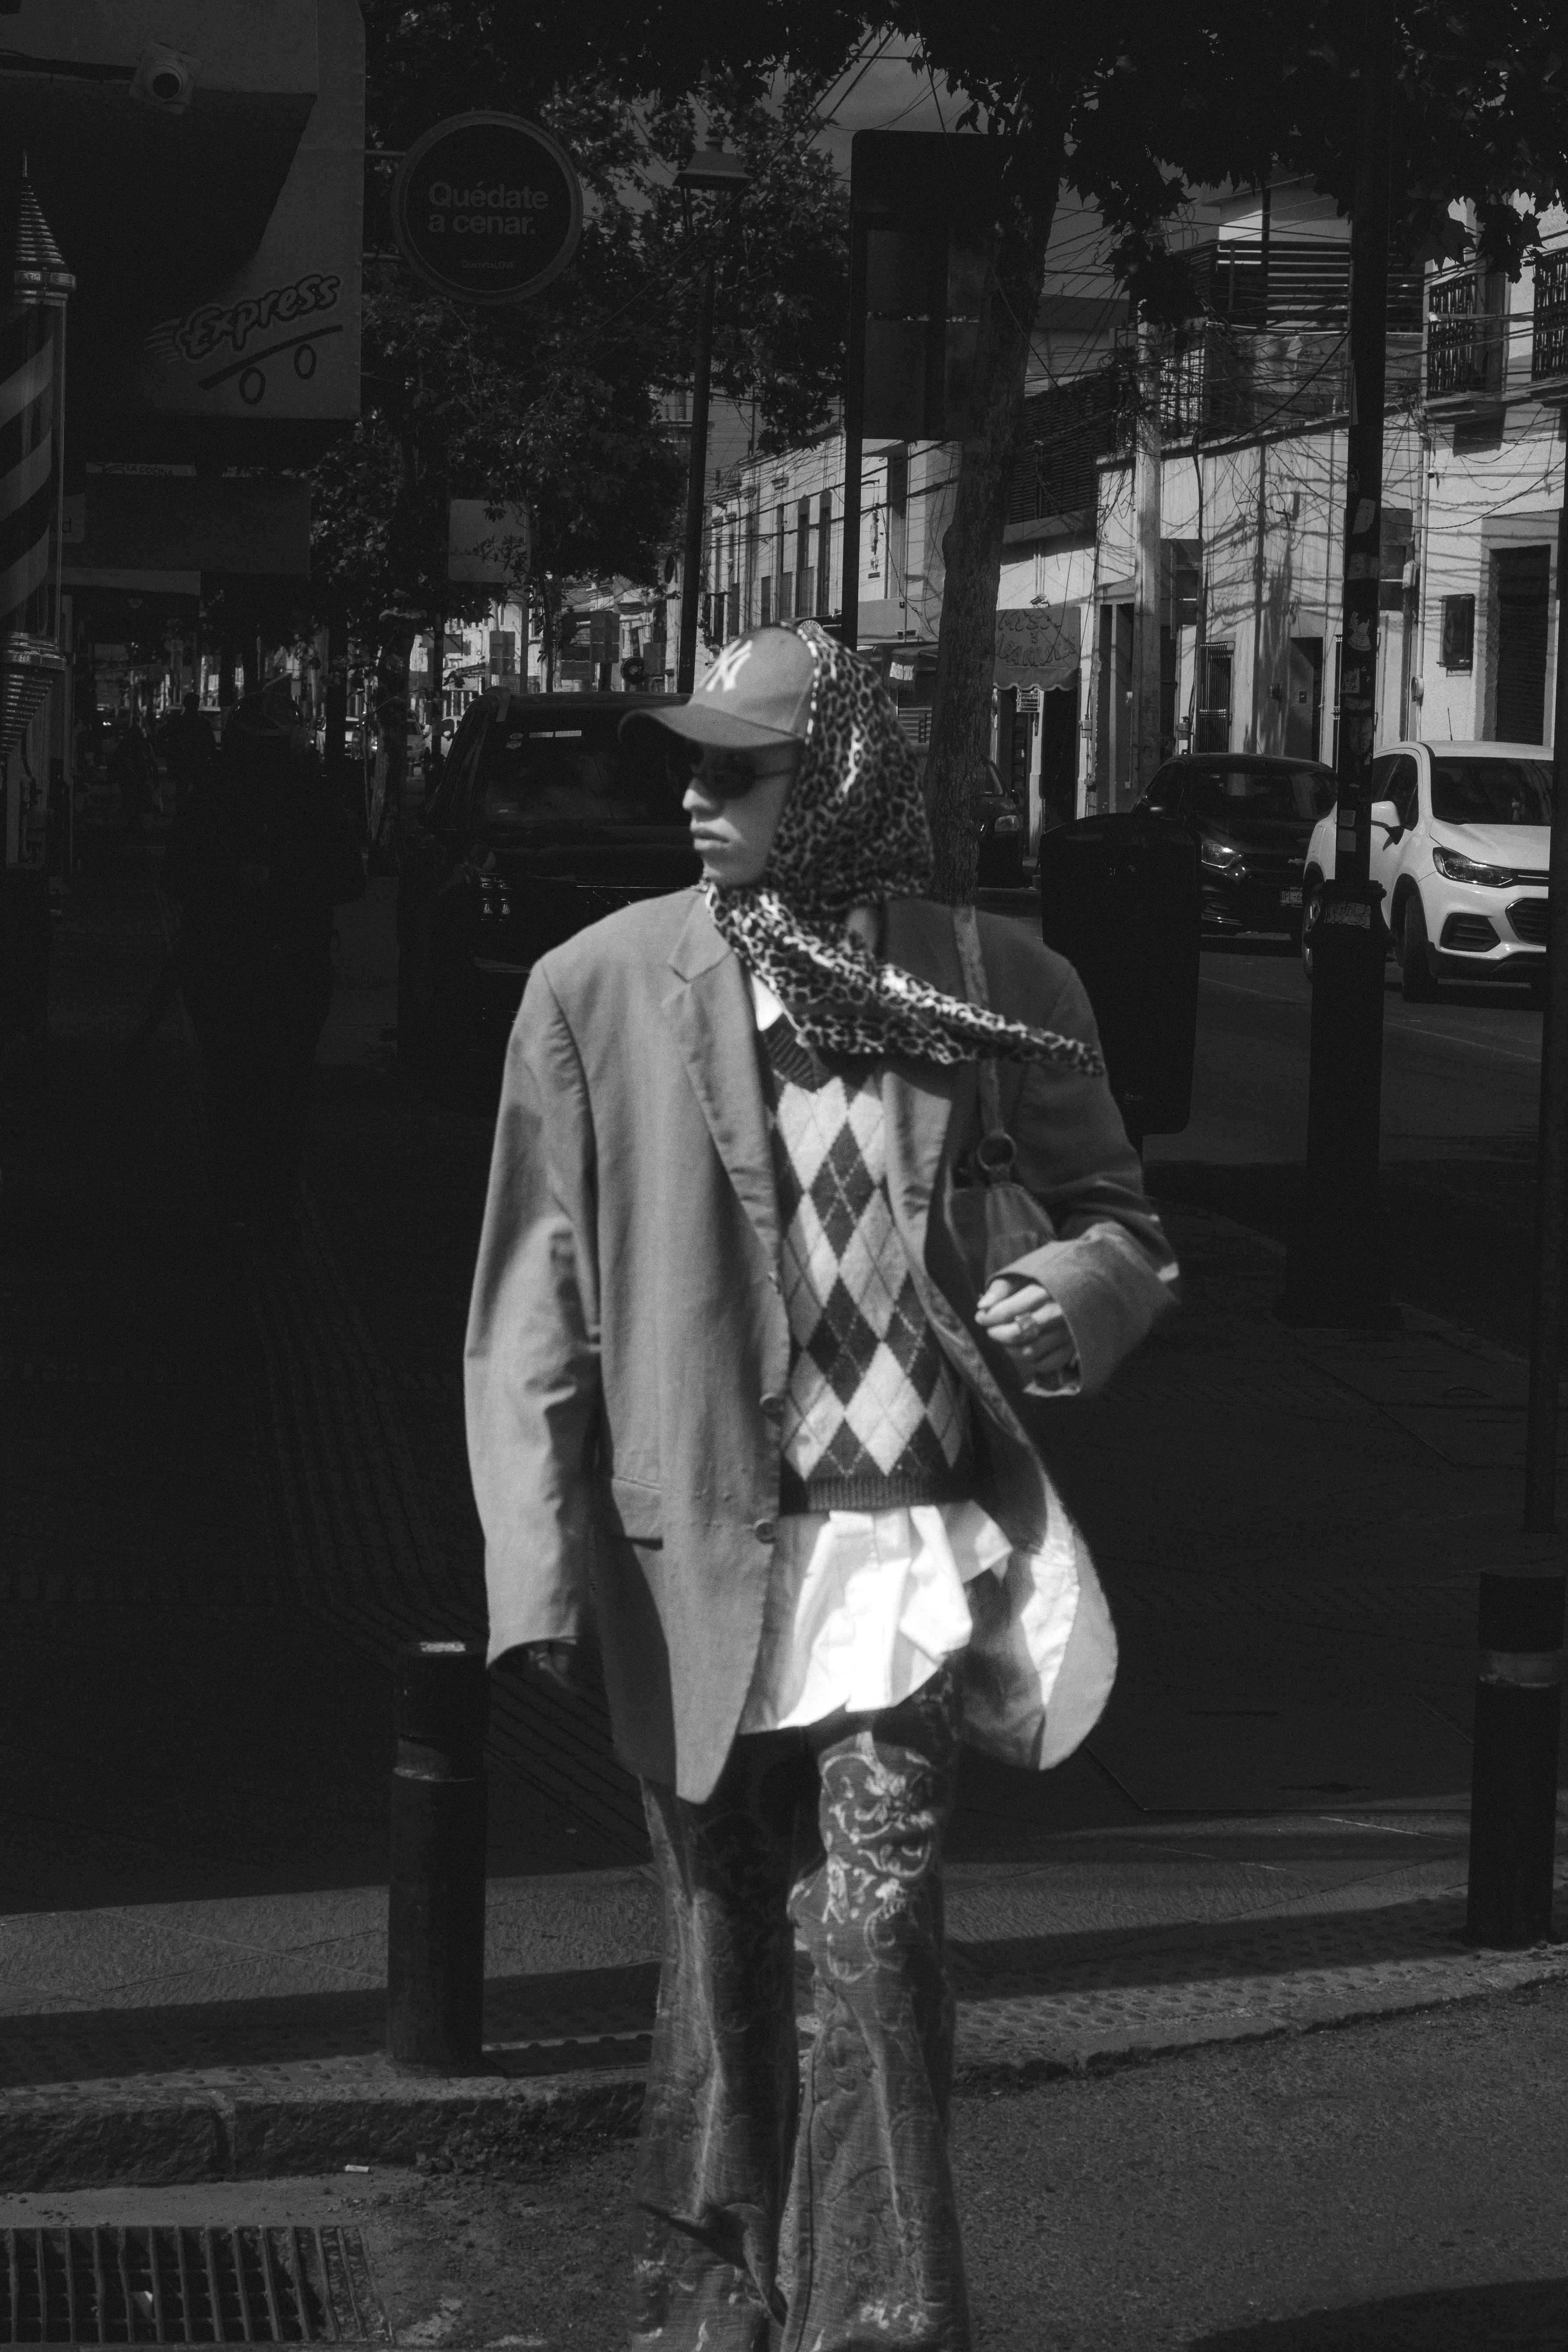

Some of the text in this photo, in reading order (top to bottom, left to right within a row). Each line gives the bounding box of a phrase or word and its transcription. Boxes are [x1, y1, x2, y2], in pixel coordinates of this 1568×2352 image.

[429, 180, 548, 209] Quédate
[428, 214, 535, 235] a cenar.
[180, 274, 341, 360] Express
[139, 466, 173, 476] COCINA
[699, 638, 753, 692] NY
